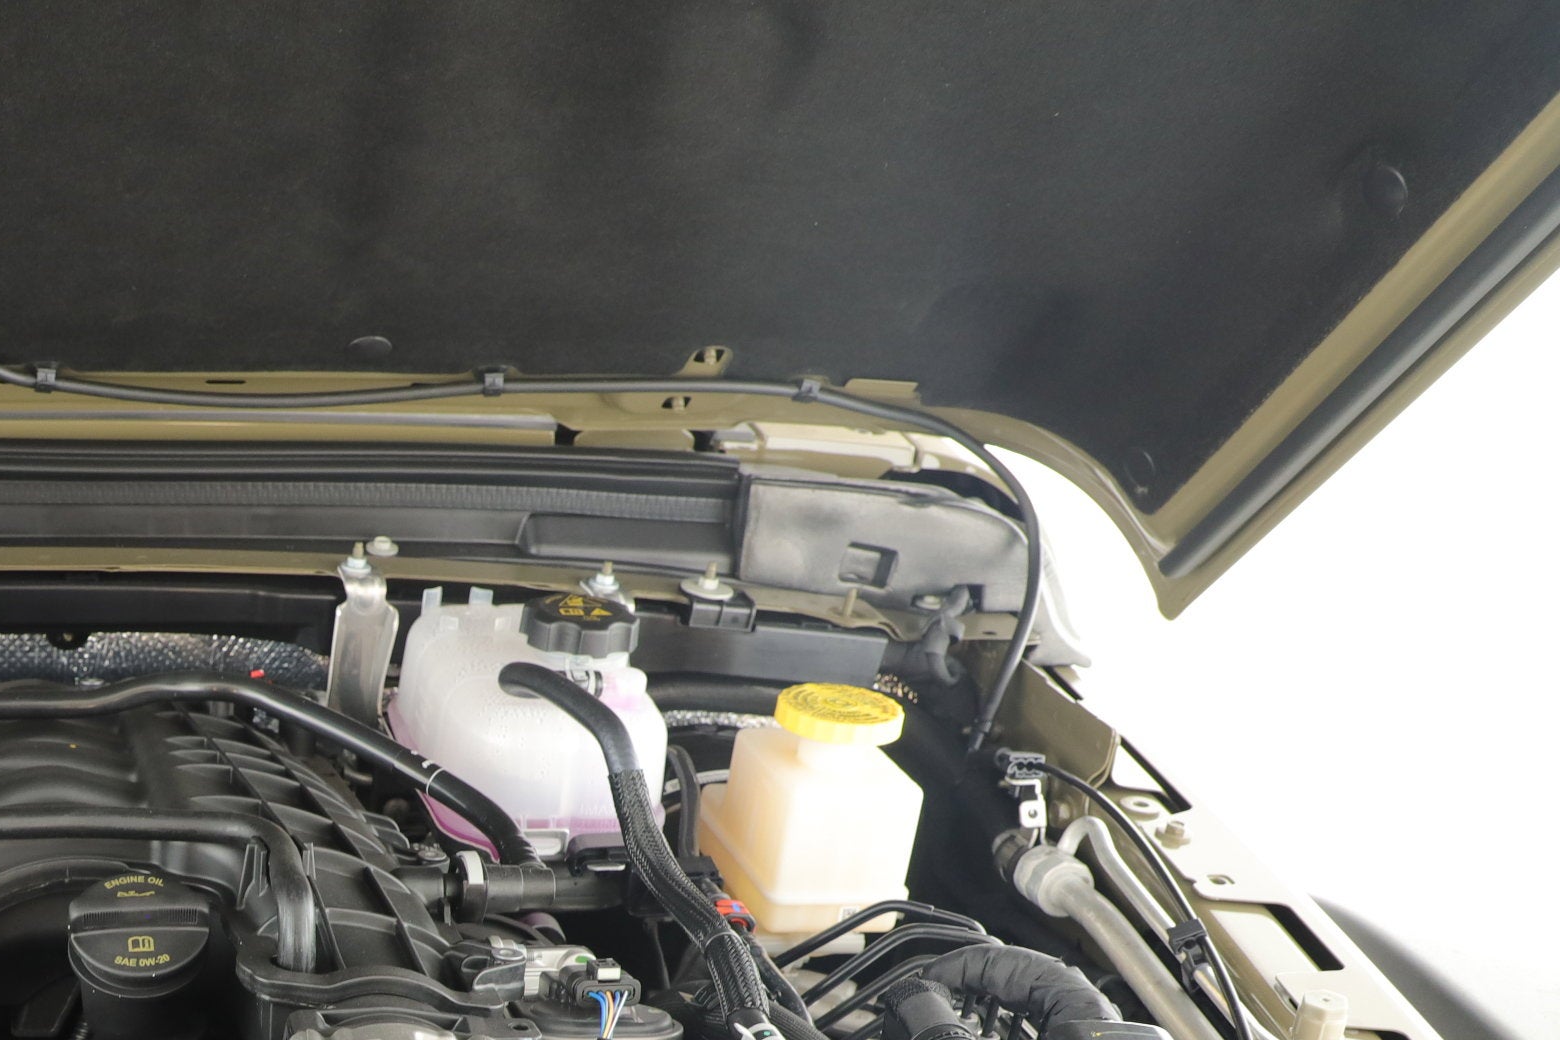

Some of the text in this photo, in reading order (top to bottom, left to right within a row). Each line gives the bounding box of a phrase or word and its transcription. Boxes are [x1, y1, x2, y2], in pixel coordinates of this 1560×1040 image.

[104, 875, 164, 889] ENGINE OIL
[114, 954, 170, 967] SAE 0W-20
